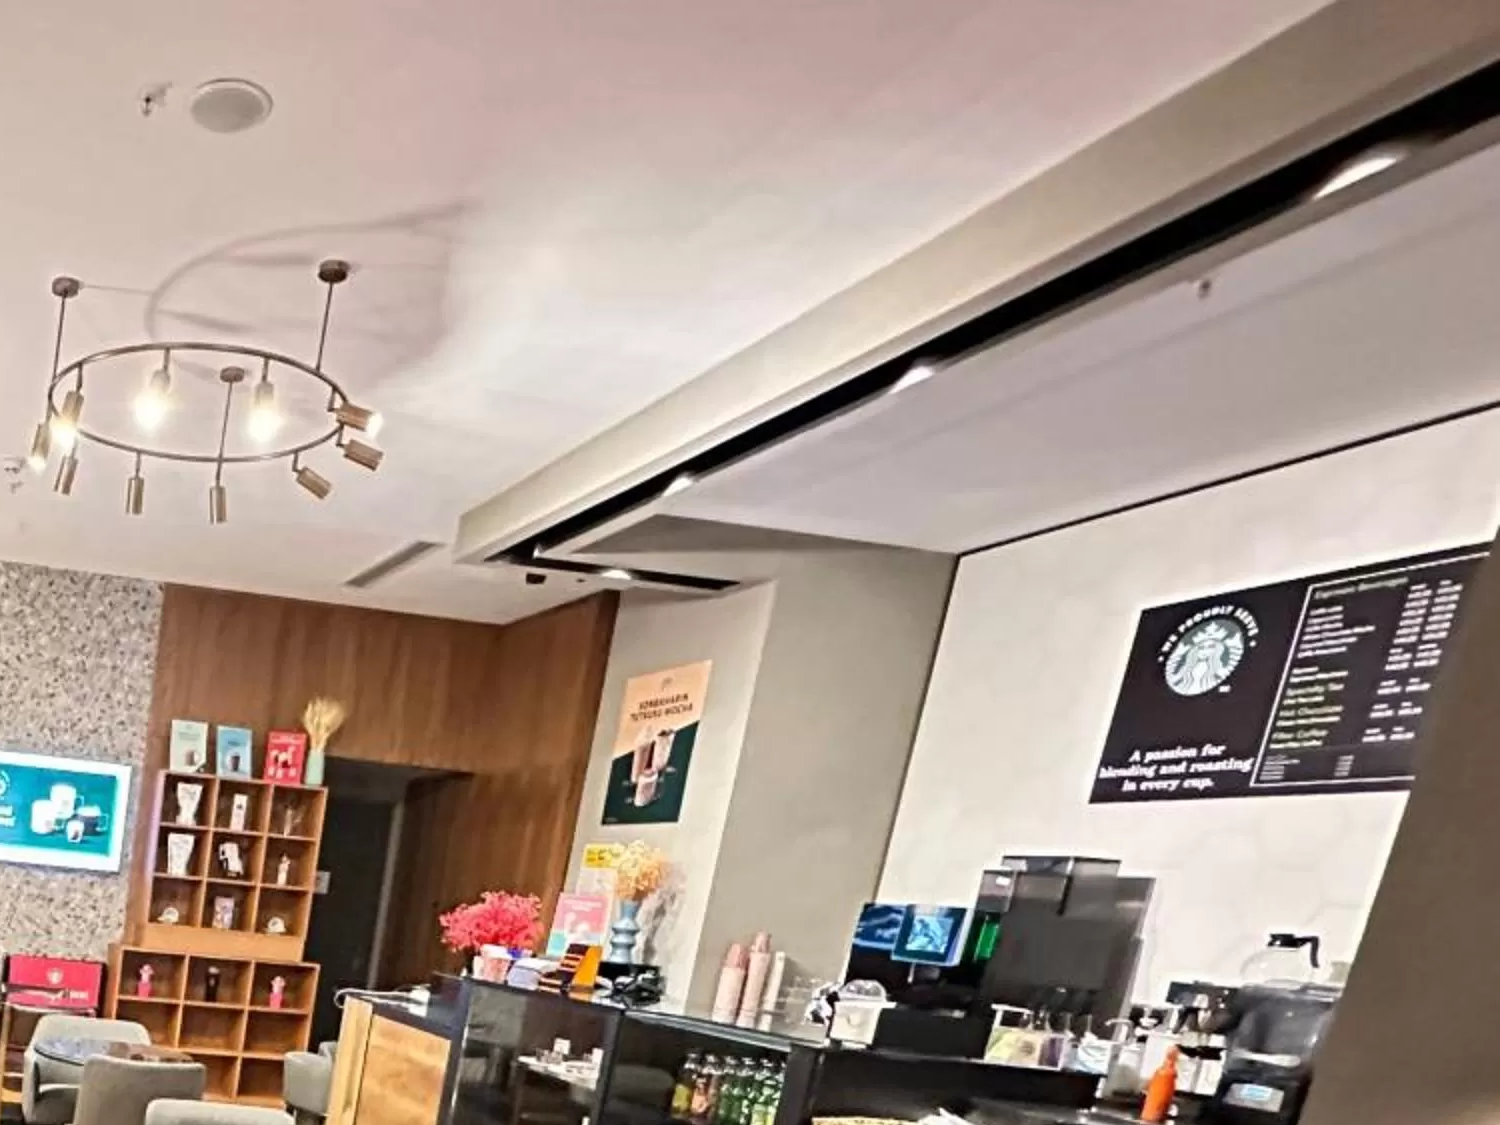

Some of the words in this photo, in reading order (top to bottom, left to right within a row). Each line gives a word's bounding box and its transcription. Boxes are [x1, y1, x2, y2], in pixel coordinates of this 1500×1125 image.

[1129, 750, 1141, 762] A
[1144, 745, 1197, 763] passion
[1200, 743, 1227, 757] for
[1159, 761, 1186, 775] and
[1189, 757, 1255, 773] roasting
[1121, 779, 1137, 792] in
[1139, 778, 1180, 792] every
